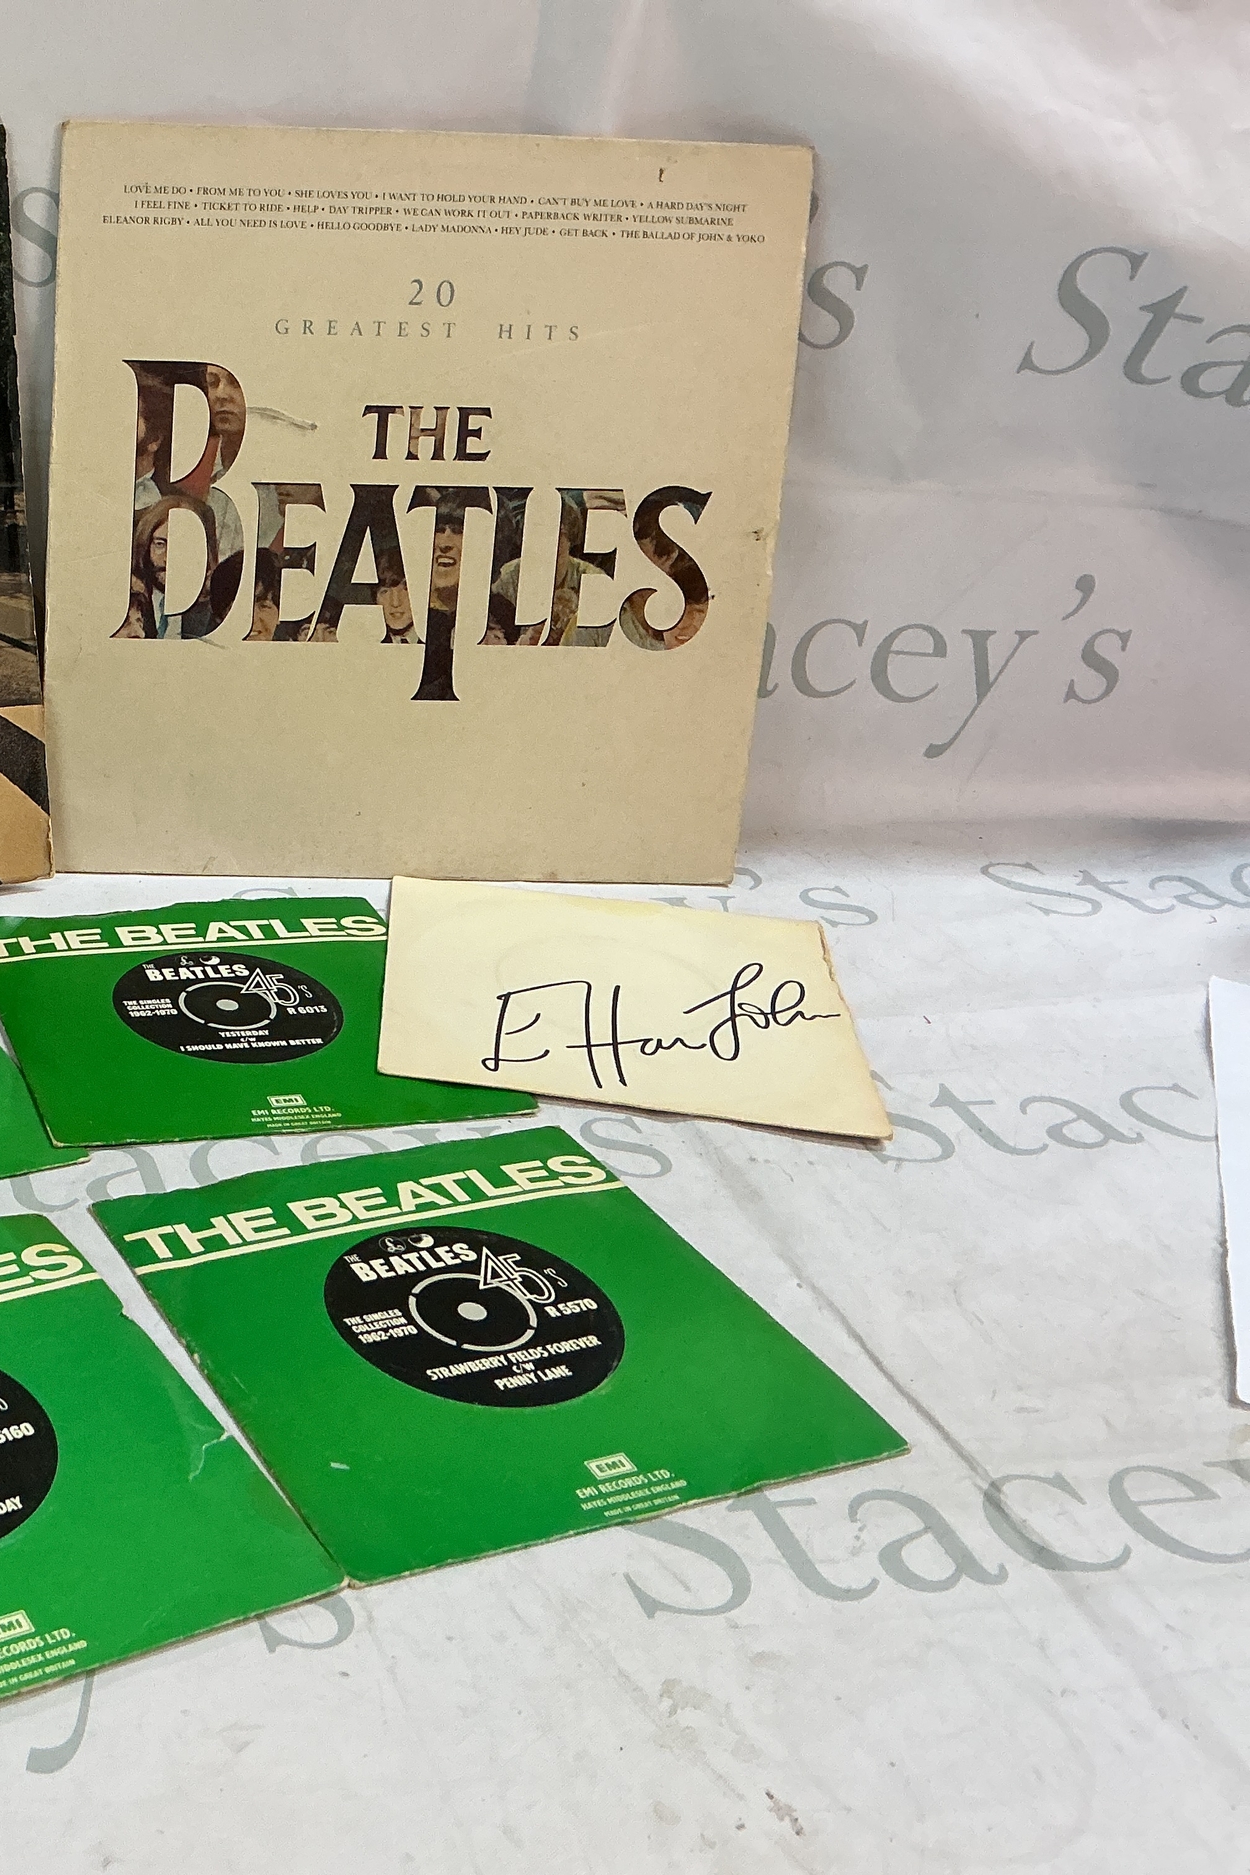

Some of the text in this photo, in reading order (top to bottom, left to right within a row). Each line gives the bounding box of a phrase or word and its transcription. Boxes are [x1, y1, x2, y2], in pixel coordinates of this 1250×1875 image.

[124, 185, 150, 194] LOVE
[154, 186, 169, 194] ME
[172, 186, 186, 194] DO
[197, 187, 226, 196] FROM
[229, 187, 244, 196] ME
[248, 188, 261, 197] TO
[263, 188, 285, 197] YOU
[295, 190, 316, 198] SHE
[317, 191, 348, 199] LOVES
[351, 191, 372, 199] YOU
[388, 192, 418, 201] WANT
[421, 193, 434, 201] TO
[437, 194, 465, 203] HOLD
[468, 195, 495, 203] YOUR
[499, 196, 527, 204] HAND
[539, 197, 568, 205] CAN'T
[570, 198, 592, 206] BUY
[593, 199, 610, 207] ME
[611, 200, 637, 208] LOVE
[656, 201, 684, 210] HARD
[686, 202, 713, 211] DAY'S
[715, 203, 747, 212] NIGHT
[408, 279, 455, 307] 20
[275, 318, 578, 341] GREATEST HITS
[363, 405, 492, 461] THE
[109, 360, 713, 701] BEATLES
[115, 915, 387, 948] BEATLES
[145, 963, 250, 982] BEATLES
[286, 1005, 327, 1015] R 6013
[218, 1029, 269, 1037] YESTERDAY
[225, 1042, 250, 1050] HAVE
[251, 1040, 288, 1048] KNOWN
[289, 1038, 323, 1046] BETTER
[123, 1207, 290, 1260] THE
[286, 1155, 607, 1231] BEATLES
[343, 1253, 361, 1264] THE
[350, 1242, 478, 1282] BEATLES
[343, 1308, 403, 1327] THE SINGLES
[544, 1298, 598, 1318] R 5570
[351, 1317, 407, 1333] COLLECTION
[358, 1325, 418, 1345] 1962-1970
[426, 1334, 602, 1381] STRAWBERRY FIELDS FOREVER
[494, 1364, 573, 1391] PENNY LANE
[575, 1469, 675, 1499] EMI RECORDS LTD.
[45, 1628, 76, 1644] LTD.
